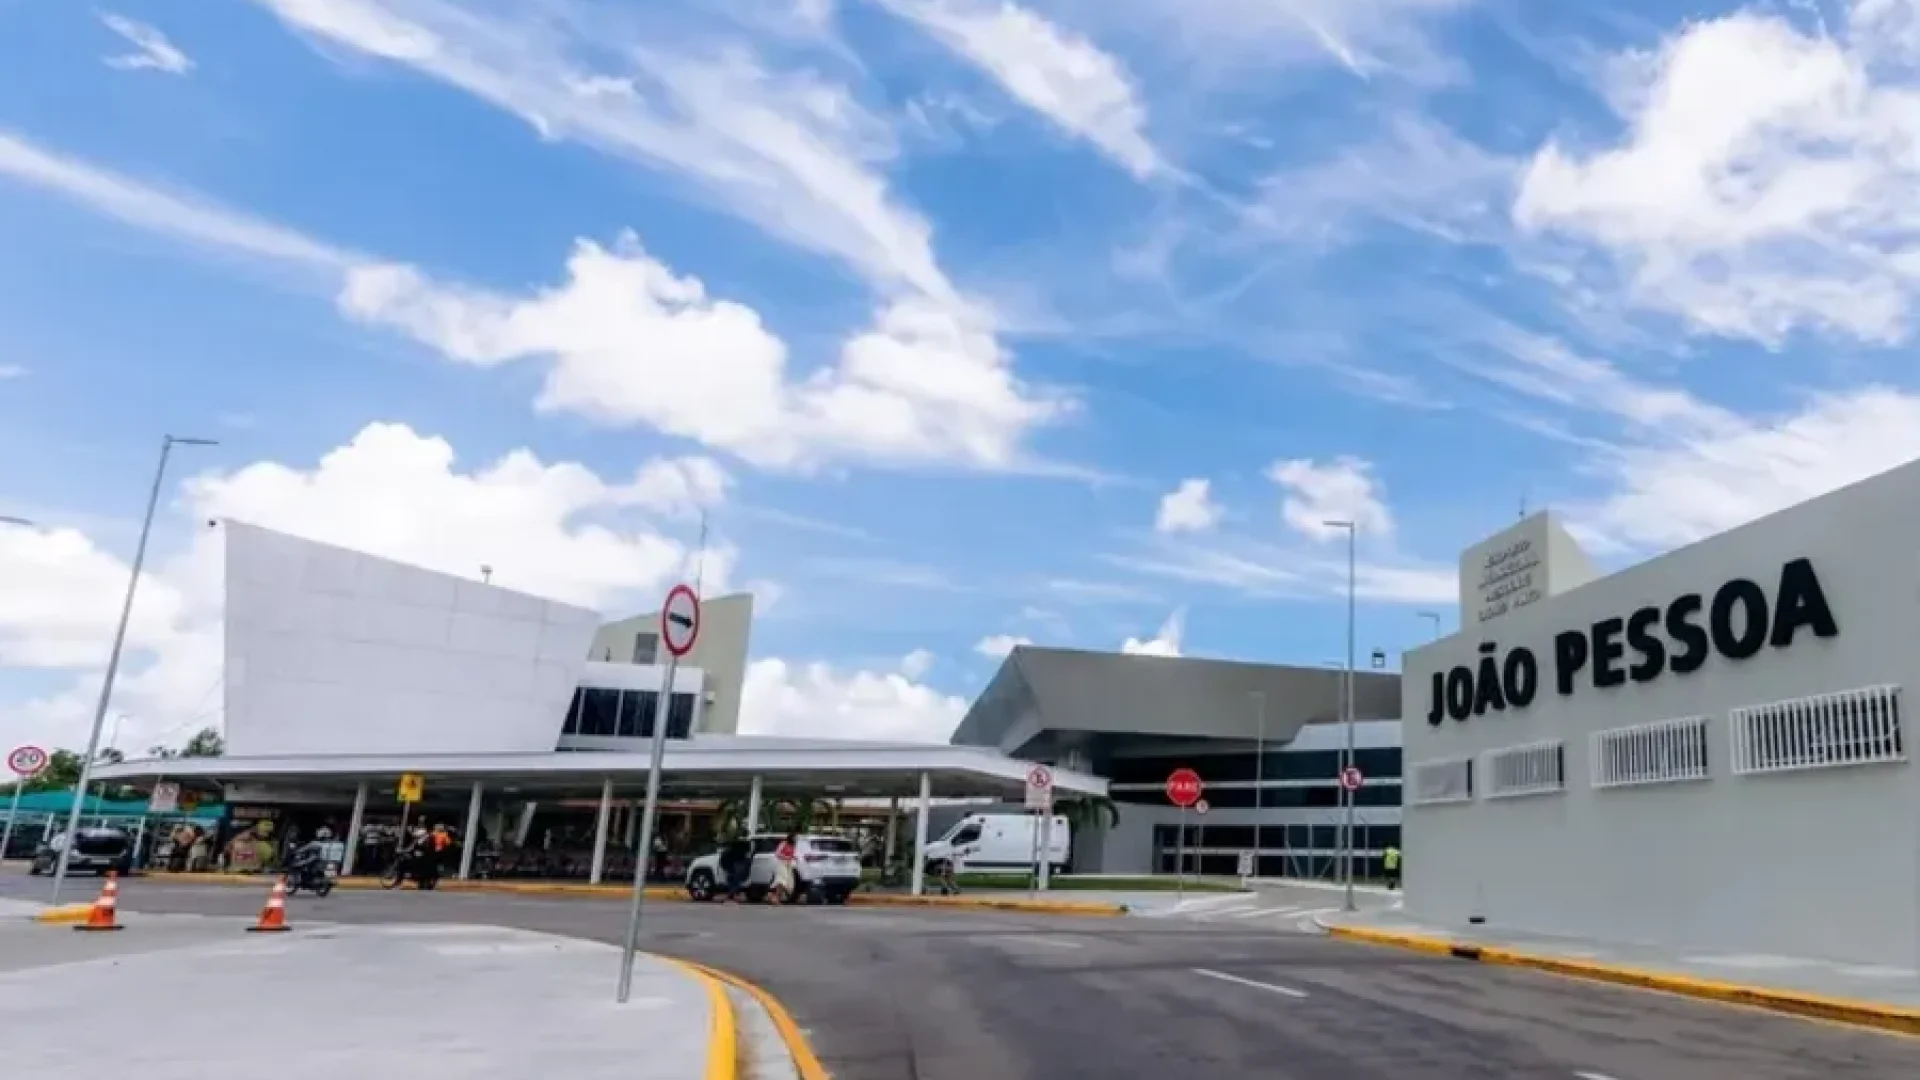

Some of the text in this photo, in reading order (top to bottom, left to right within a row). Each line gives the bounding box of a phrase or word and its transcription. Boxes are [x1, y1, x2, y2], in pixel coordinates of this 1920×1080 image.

[1428, 557, 1838, 726] JOÃO PESSOA
[16, 753, 39, 765] 20
